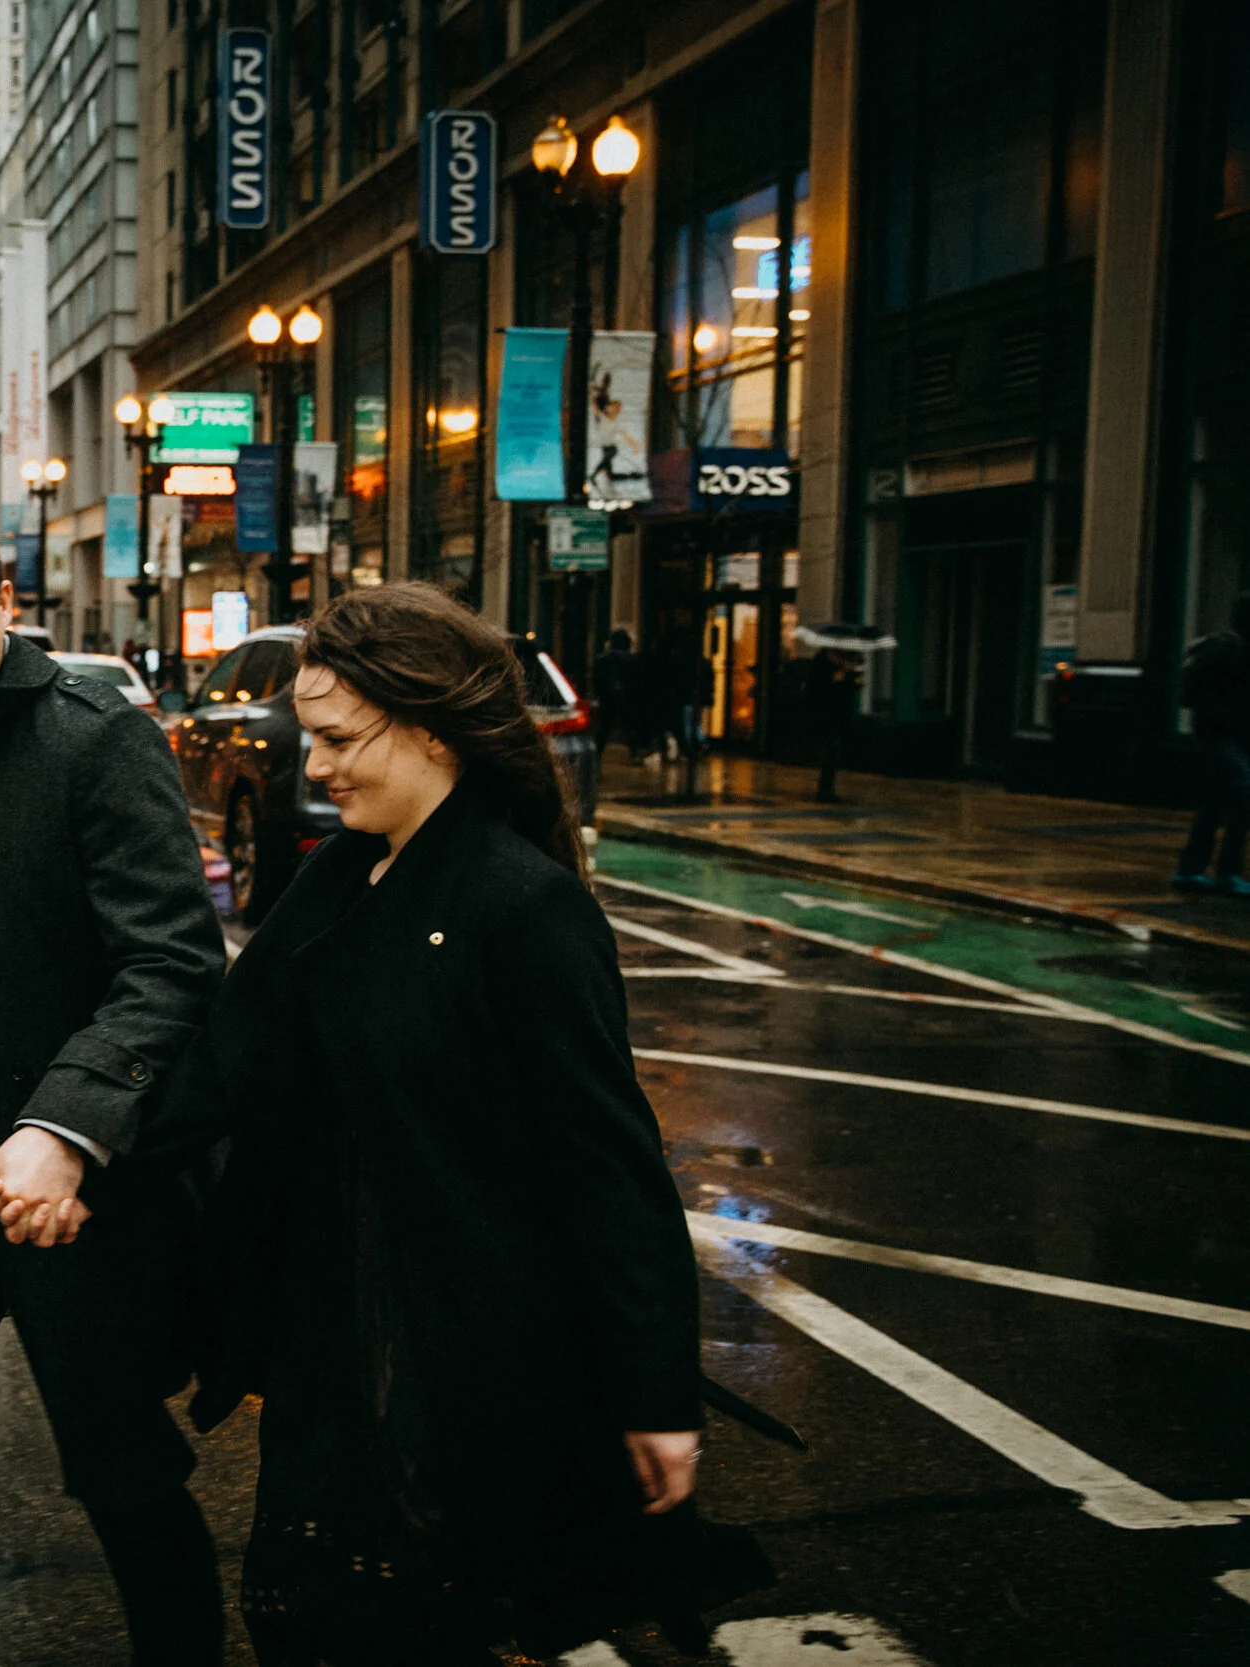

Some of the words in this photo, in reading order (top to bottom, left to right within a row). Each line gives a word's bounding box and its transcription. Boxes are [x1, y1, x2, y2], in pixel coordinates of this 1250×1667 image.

[229, 47, 266, 209] ROSS
[448, 119, 479, 246] ROSS
[698, 464, 792, 497] ROSS
